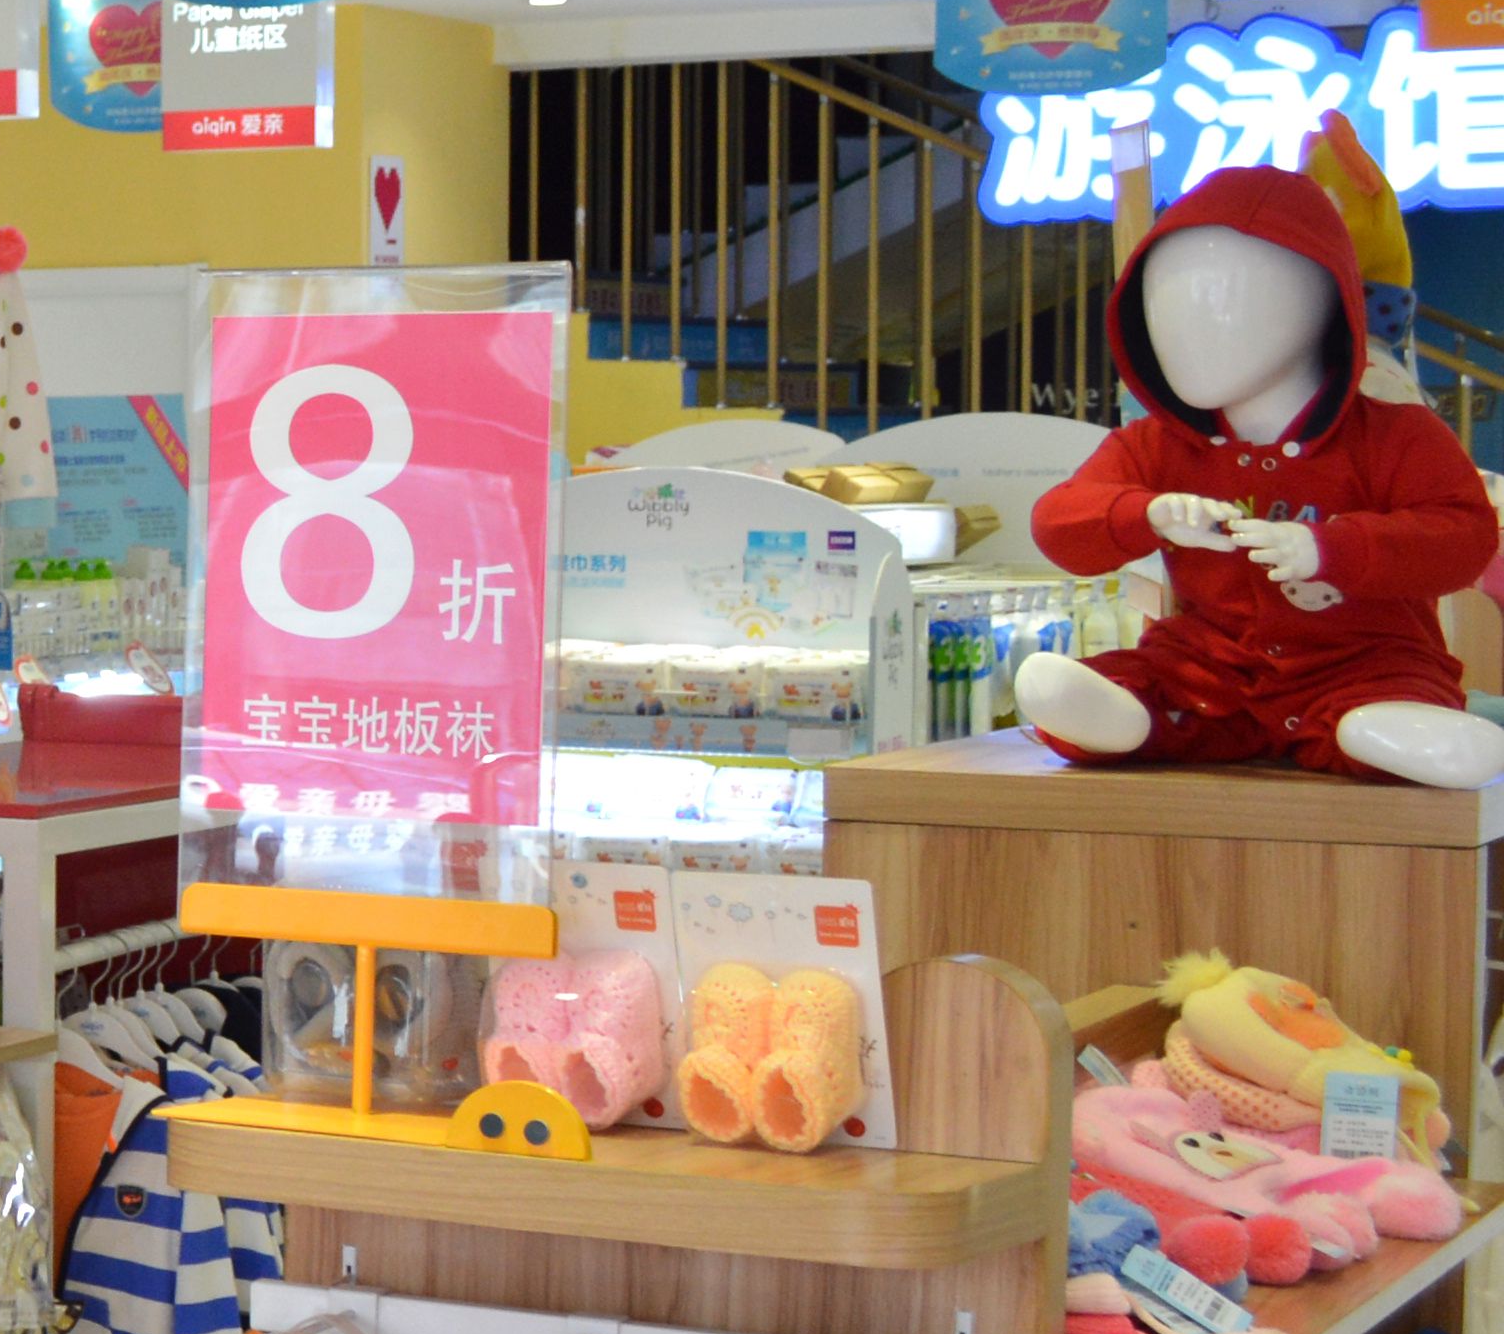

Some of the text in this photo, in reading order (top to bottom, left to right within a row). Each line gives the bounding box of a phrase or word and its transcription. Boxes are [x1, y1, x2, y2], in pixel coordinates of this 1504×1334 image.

[191, 113, 284, 137] aiqin 爱亲
[238, 363, 517, 646] 8折
[241, 693, 497, 759] 宝宝地板袜
